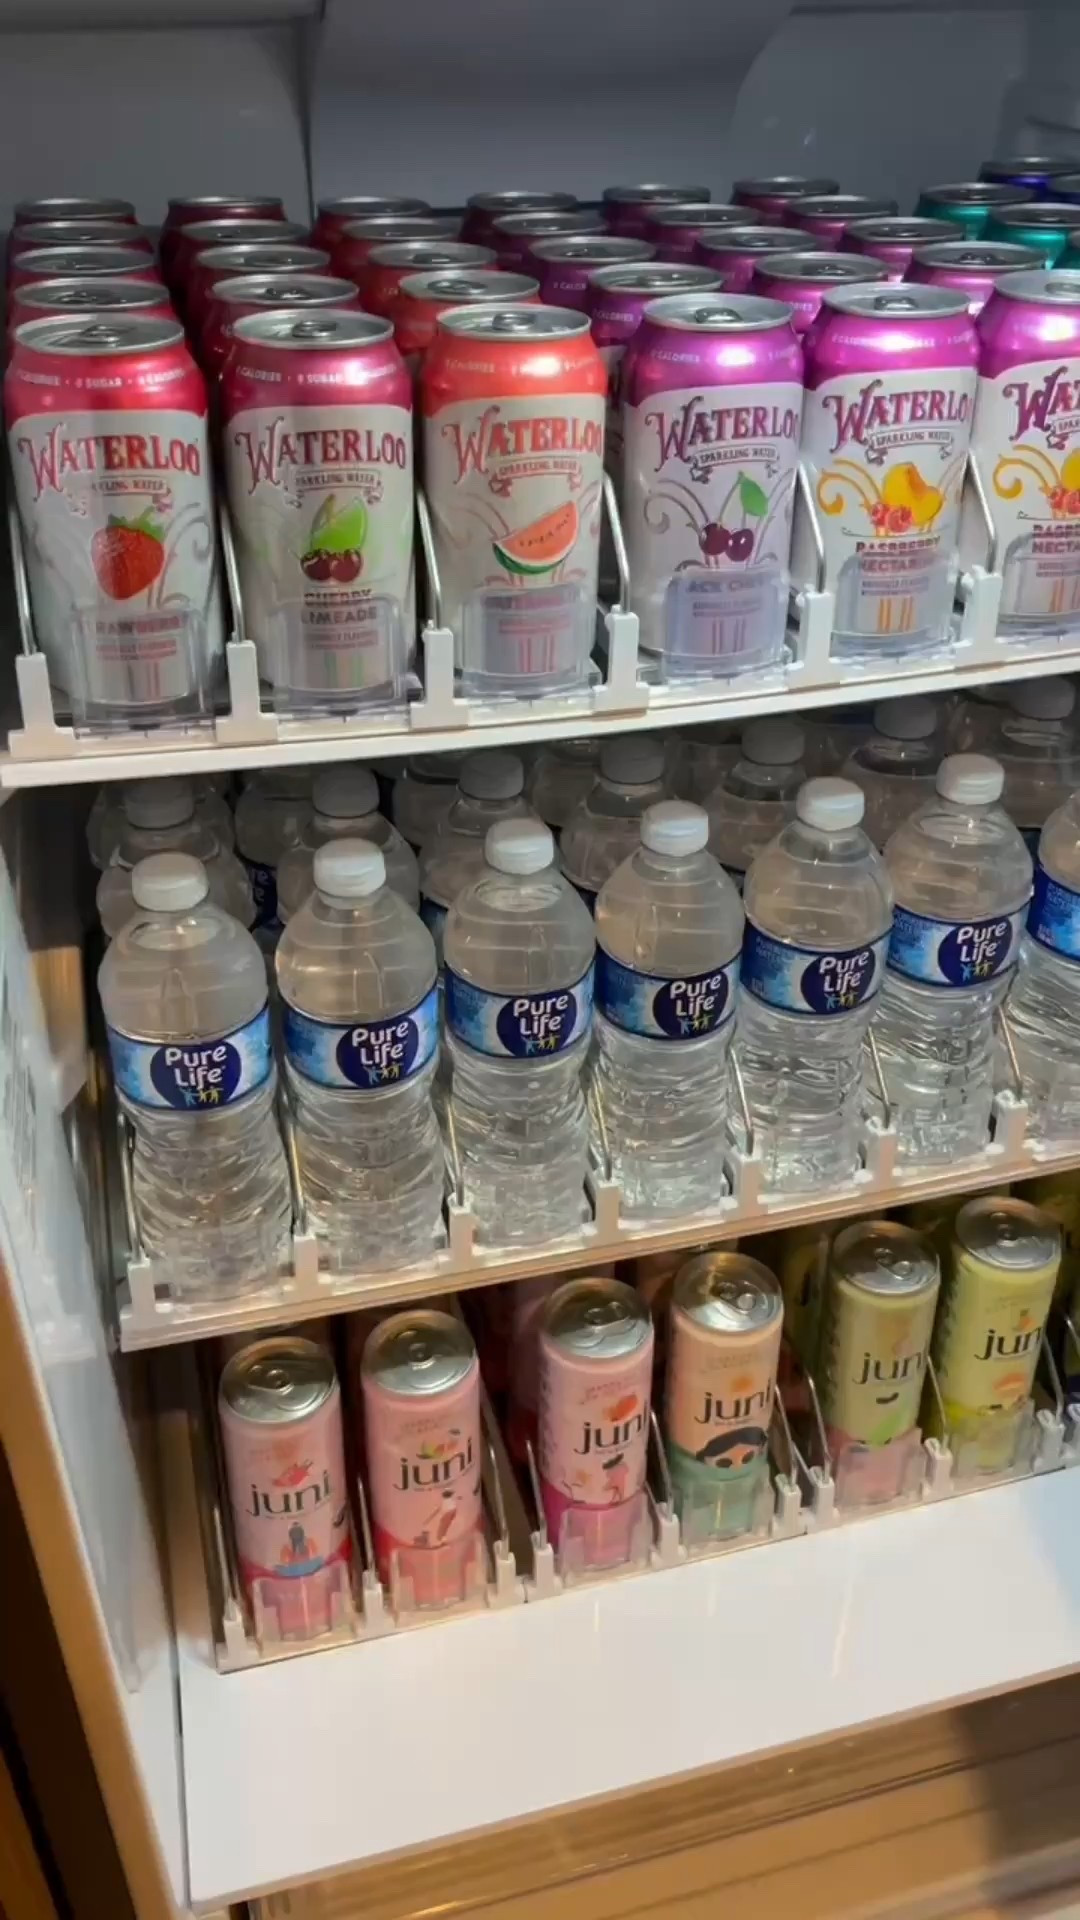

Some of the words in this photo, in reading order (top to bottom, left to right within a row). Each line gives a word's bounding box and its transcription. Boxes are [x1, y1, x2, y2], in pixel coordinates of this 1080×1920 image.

[17, 422, 201, 502] WATERLOO
[234, 416, 406, 496] WATERLOO
[957, 921, 1006, 944] Pure
[819, 950, 869, 975] Pure
[961, 940, 997, 964] Life
[670, 973, 721, 999] Pure
[823, 970, 861, 994] Life
[513, 994, 568, 1017] Pure
[676, 995, 715, 1018] Life
[352, 1017, 409, 1047] Pure
[520, 1013, 561, 1039] Life
[165, 1045, 226, 1067] Pure
[360, 1043, 404, 1068] Life
[175, 1066, 223, 1090] Life
[974, 1326, 1042, 1360] jun
[852, 1351, 922, 1385] jun
[392, 1436, 472, 1491] juni
[245, 1469, 329, 1517] juni
